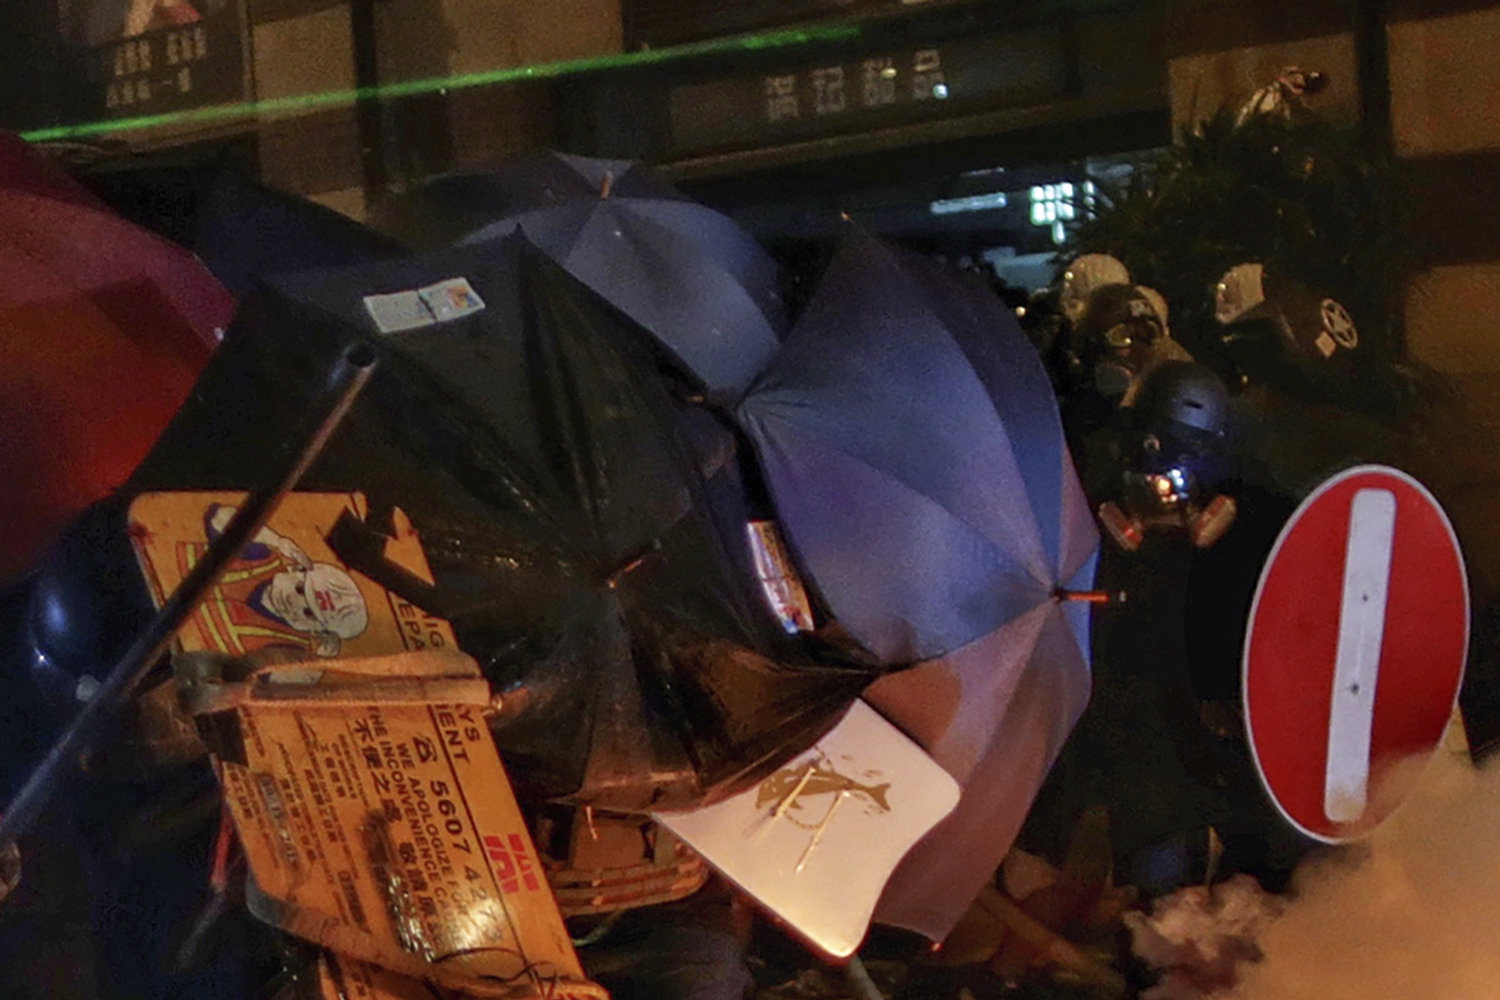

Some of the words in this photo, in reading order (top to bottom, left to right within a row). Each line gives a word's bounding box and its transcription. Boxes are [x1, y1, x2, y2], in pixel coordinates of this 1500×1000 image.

[365, 704, 389, 738] THE
[378, 740, 441, 881] INCONVENIENCE
[394, 741, 416, 771] WE
[407, 777, 454, 876] APOLOGIZE
[445, 879, 469, 916] FOR
[428, 780, 472, 854] 5607
